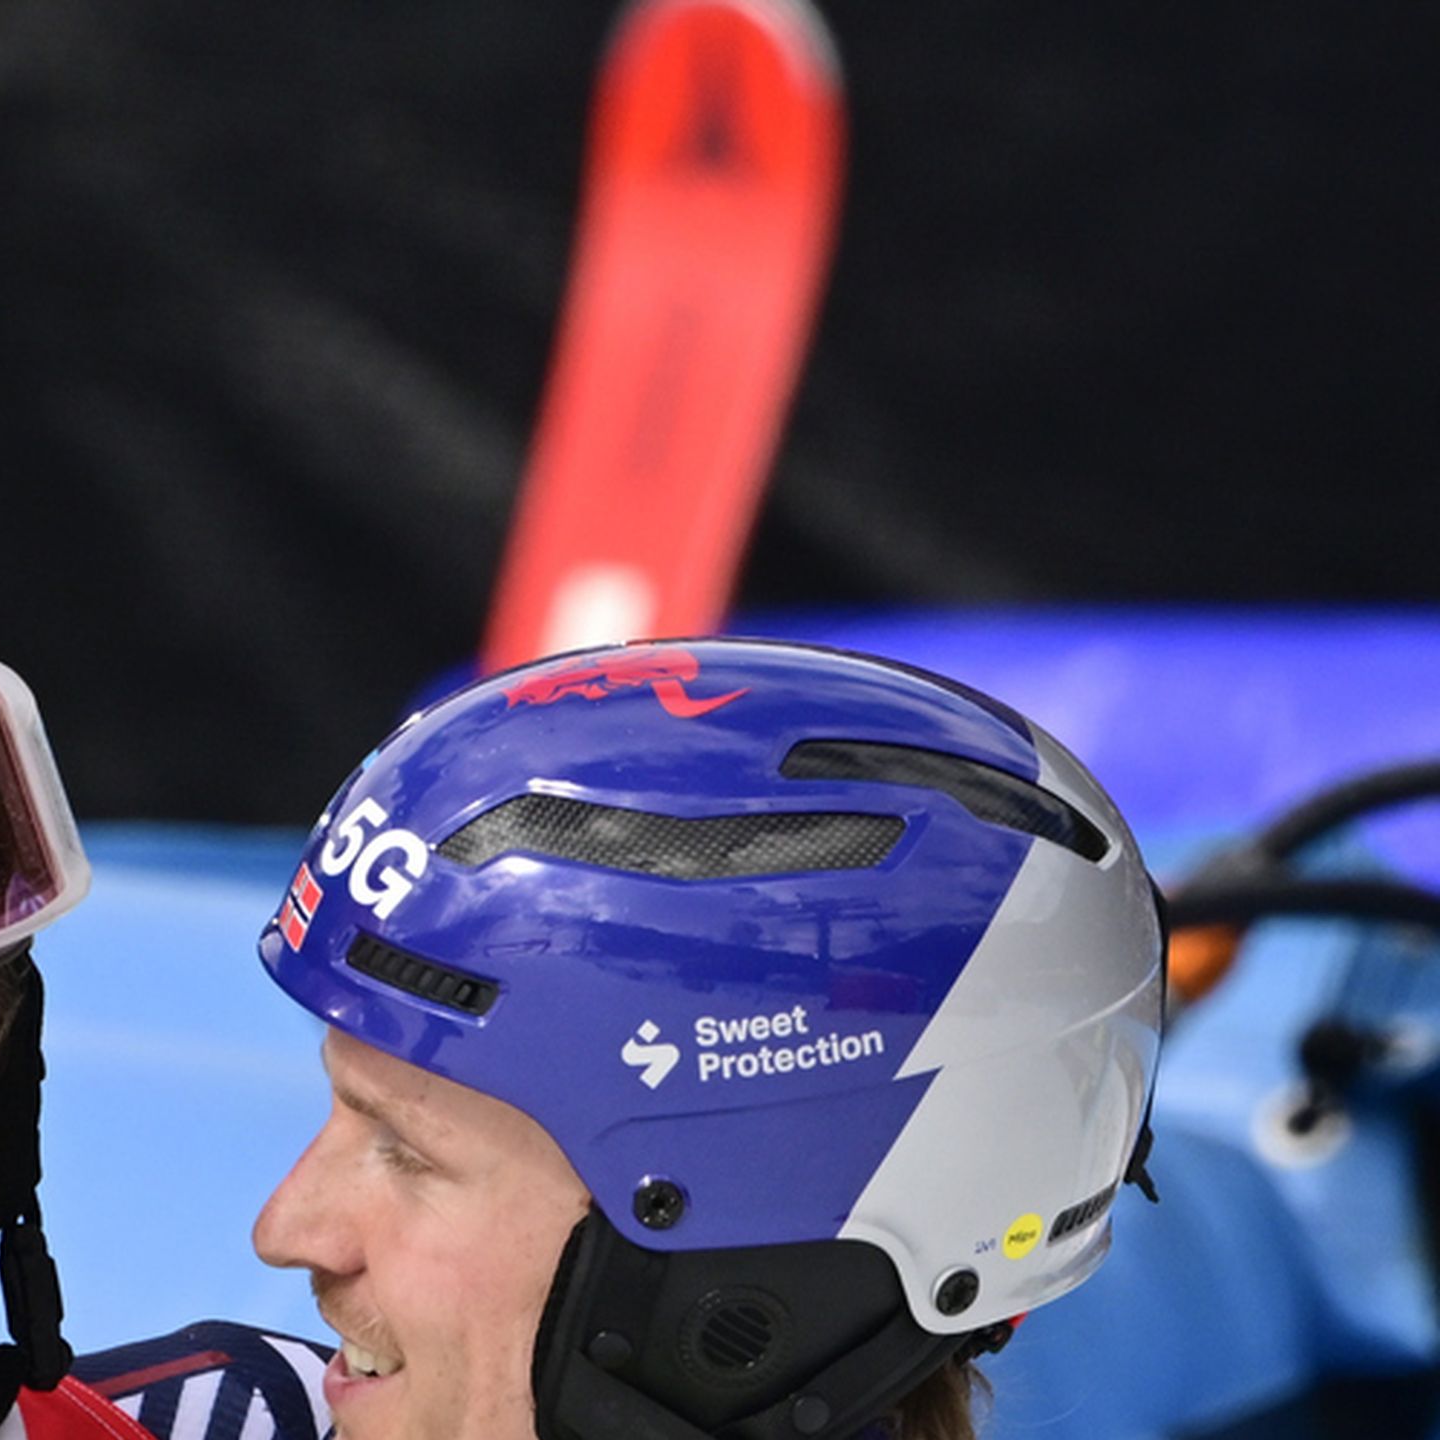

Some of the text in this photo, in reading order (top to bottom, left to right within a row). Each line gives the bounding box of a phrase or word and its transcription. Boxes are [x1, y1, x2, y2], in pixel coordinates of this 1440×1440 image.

[320, 797, 428, 921] 5G
[694, 1005, 809, 1046] Sweet
[698, 1030, 884, 1081] Protection
